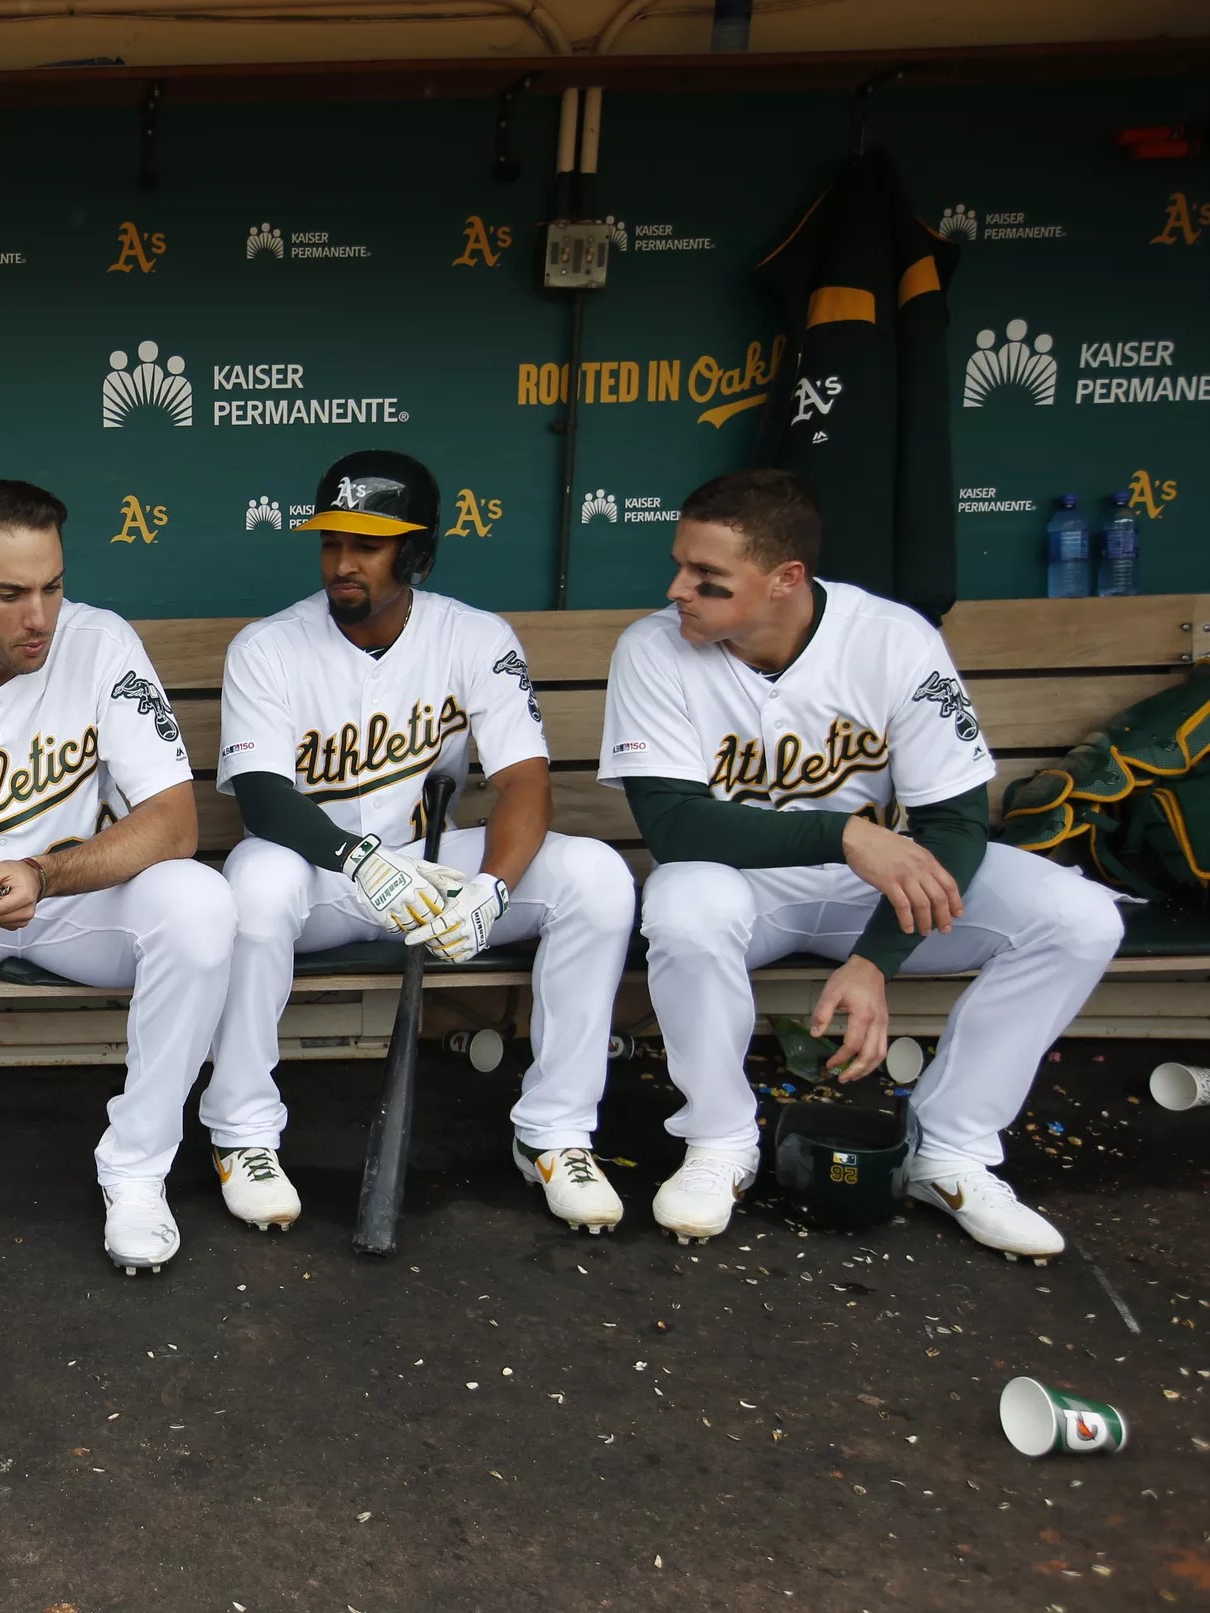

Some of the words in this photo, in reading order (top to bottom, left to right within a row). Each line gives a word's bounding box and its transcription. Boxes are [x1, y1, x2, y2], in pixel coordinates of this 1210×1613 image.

[635, 225, 672, 237] KAISER
[985, 212, 1025, 225] KAISER
[106, 222, 166, 273] A's
[291, 232, 329, 244] KAISER
[451, 215, 512, 267] A's
[1079, 341, 1175, 368] KAISER
[213, 364, 304, 390] KAISER
[647, 359, 681, 402] IN
[688, 333, 787, 404] Oakl
[791, 376, 842, 426] A's
[1075, 375, 1210, 404] PERMANE
[625, 497, 661, 508] KAISER
[959, 487, 996, 498] KAISER
[110, 495, 168, 544] A's
[290, 505, 315, 516] KAIS
[444, 488, 502, 538] A's
[624, 510, 681, 522] PERMANE
[296, 694, 469, 785] Athletis
